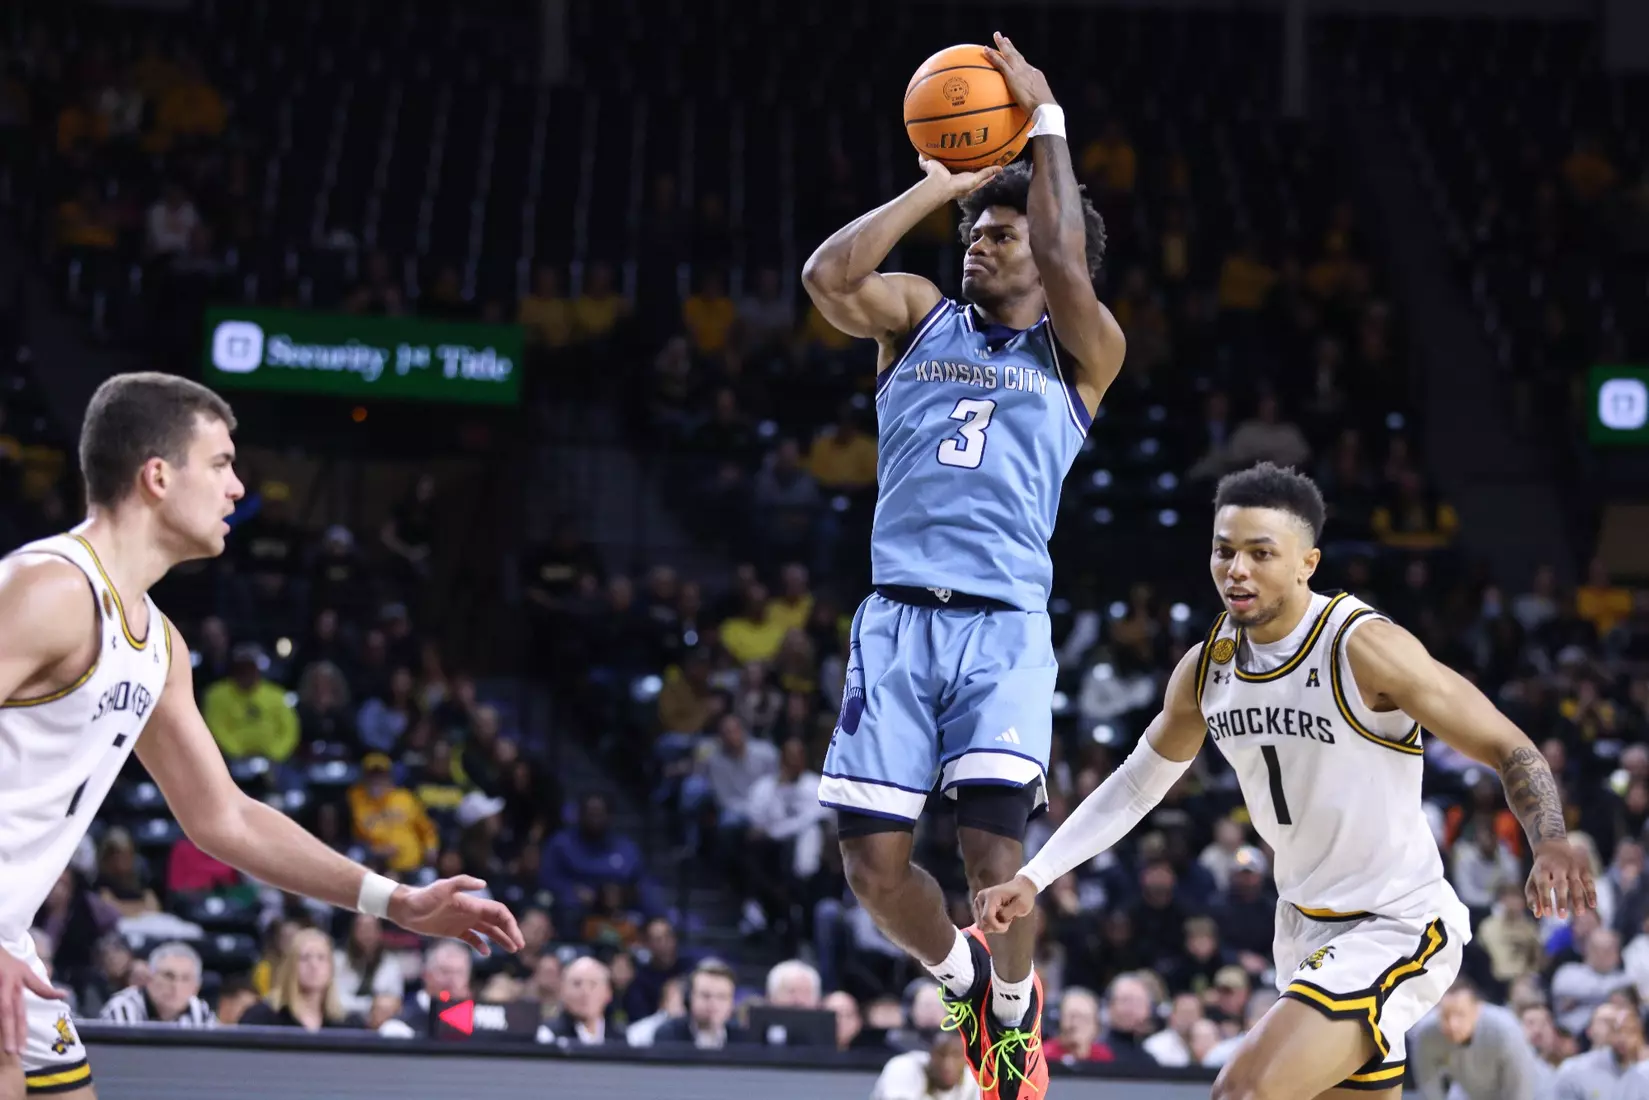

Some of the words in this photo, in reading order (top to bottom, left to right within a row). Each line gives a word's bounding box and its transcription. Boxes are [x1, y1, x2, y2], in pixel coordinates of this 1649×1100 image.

[267, 333, 389, 382] Security
[436, 343, 513, 381] Title
[915, 360, 997, 389] KANSAS
[1004, 366, 1048, 395] CITY
[936, 397, 997, 470] 3
[1206, 706, 1336, 745] SHOCKERS
[1260, 744, 1293, 826] 1
